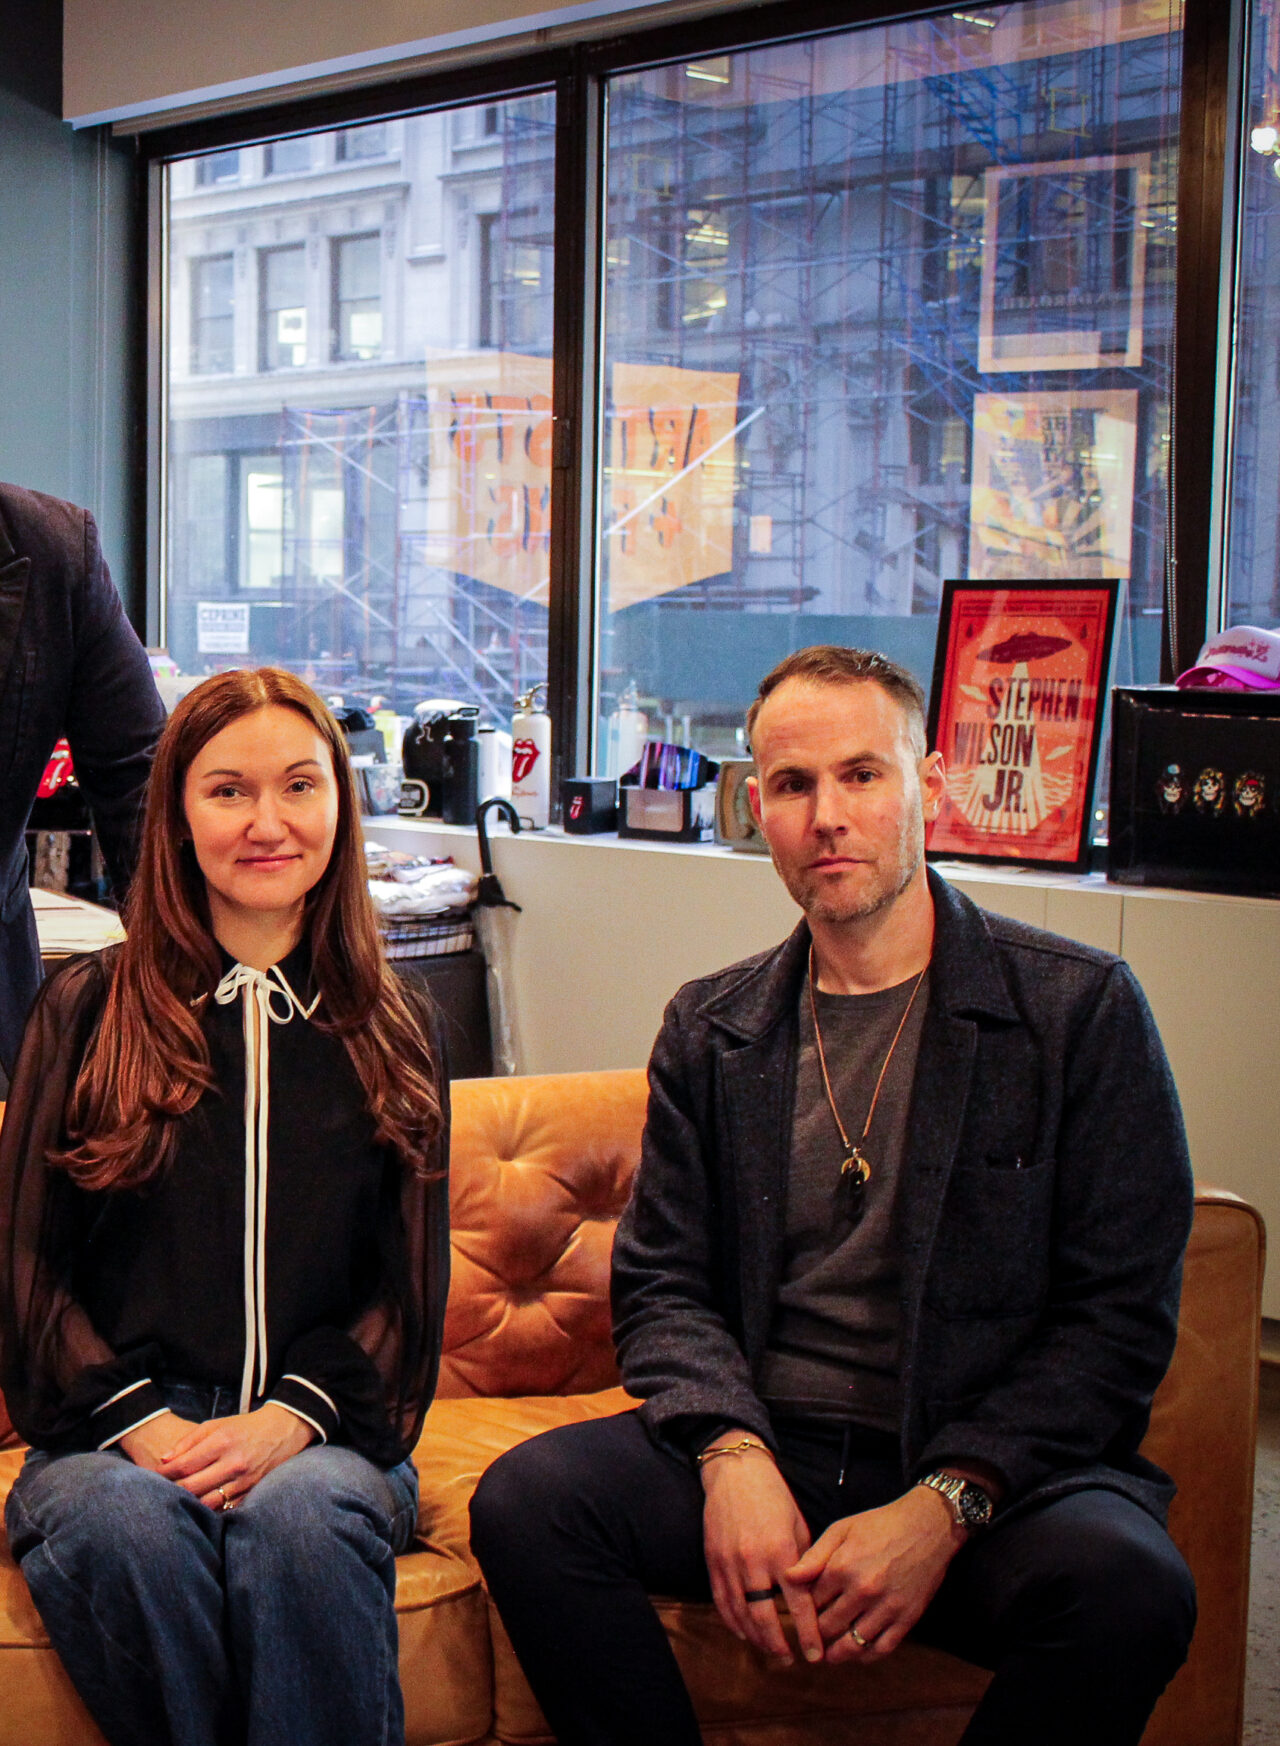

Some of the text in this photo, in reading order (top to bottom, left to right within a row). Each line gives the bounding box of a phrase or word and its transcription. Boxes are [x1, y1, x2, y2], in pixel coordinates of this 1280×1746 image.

[986, 677, 1082, 722] STEPHEN
[954, 722, 1036, 767] WILSON
[982, 769, 1028, 814] JR.
